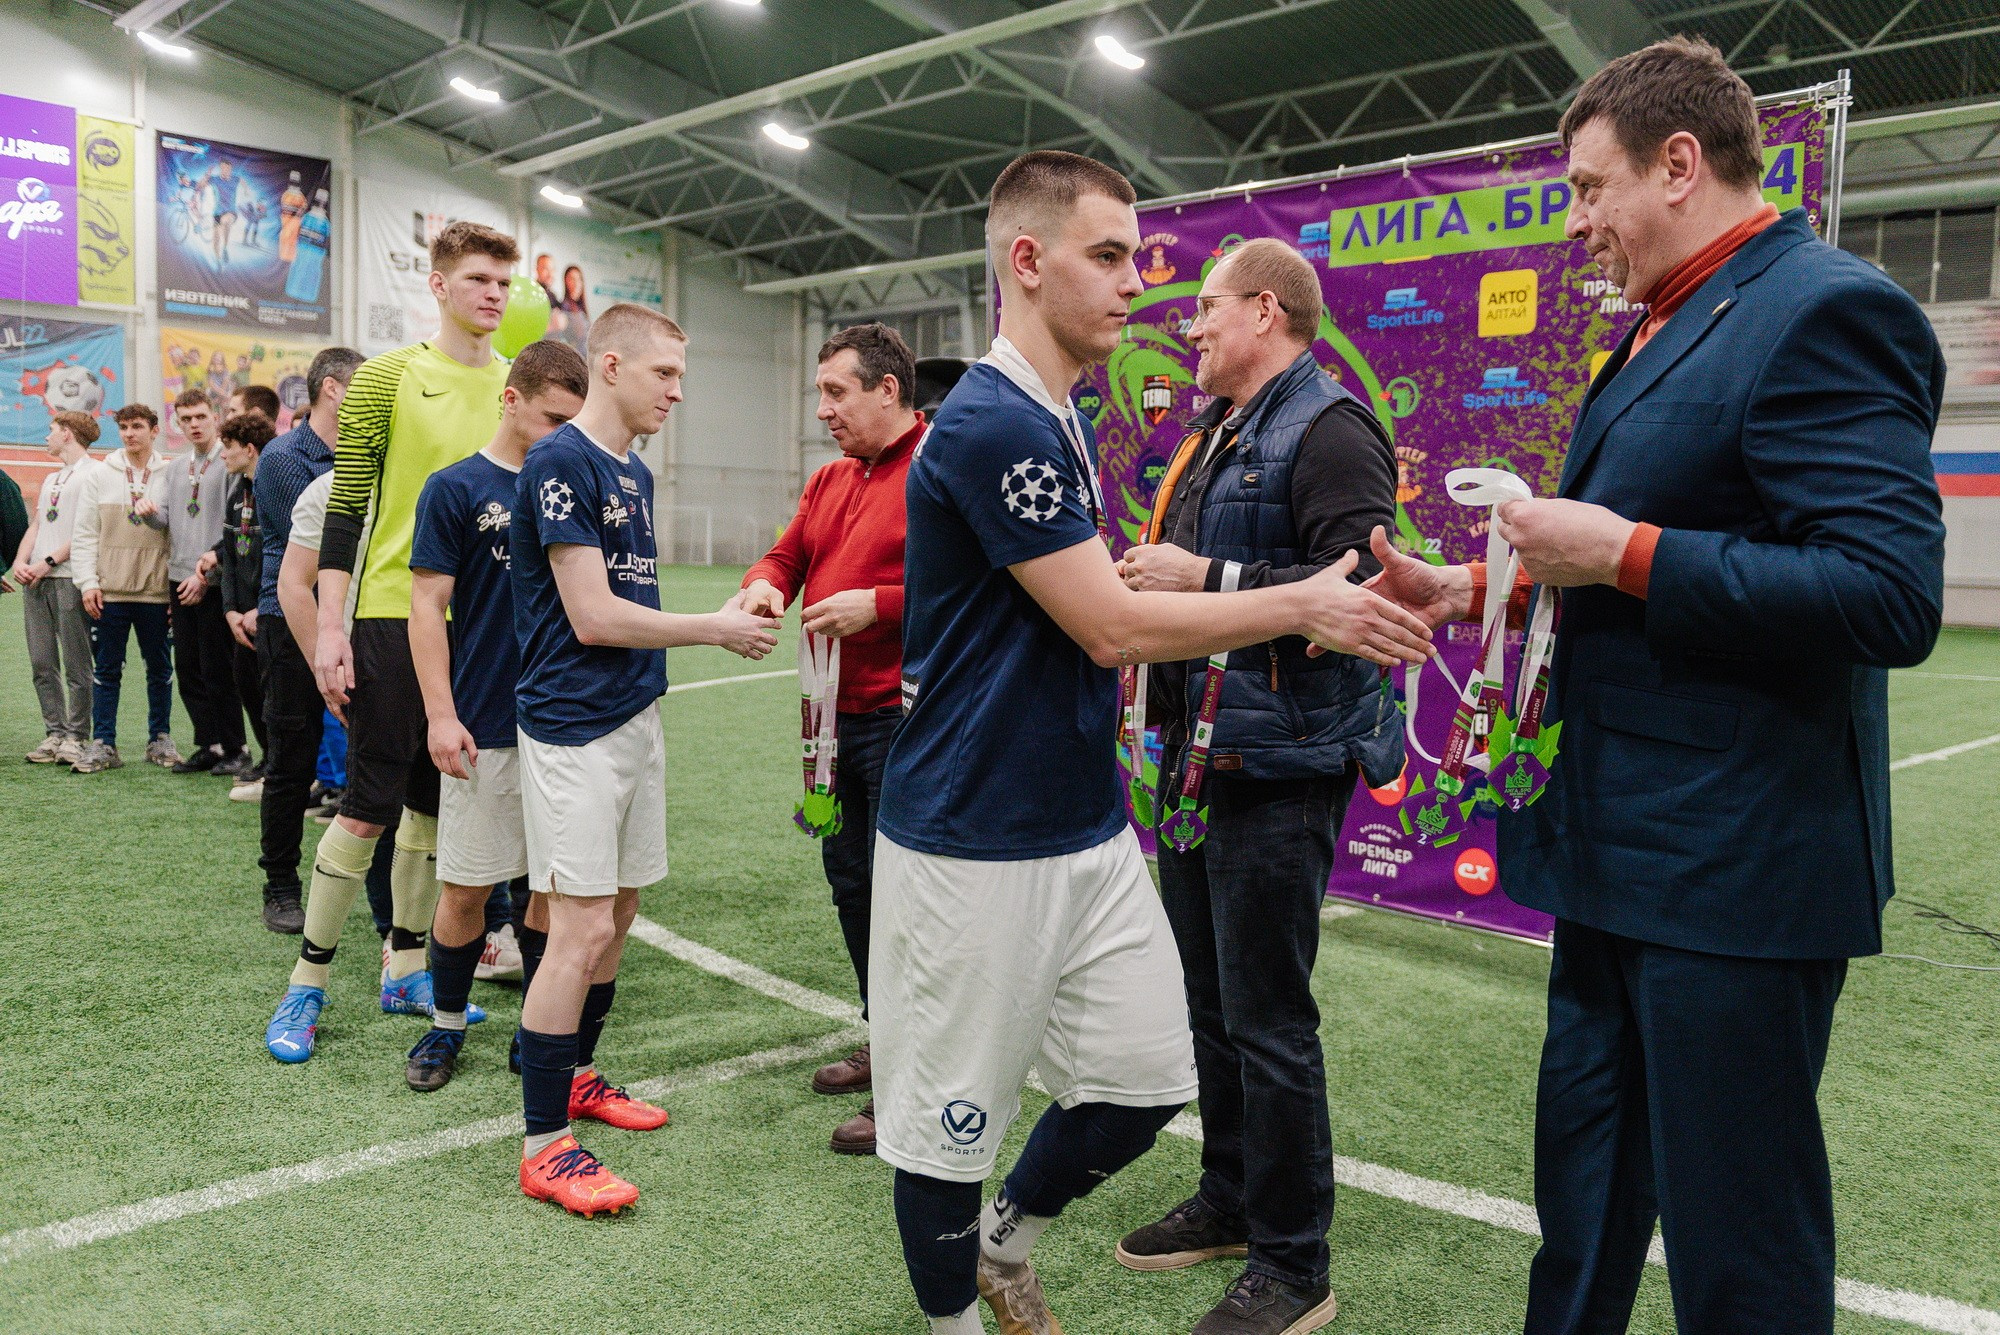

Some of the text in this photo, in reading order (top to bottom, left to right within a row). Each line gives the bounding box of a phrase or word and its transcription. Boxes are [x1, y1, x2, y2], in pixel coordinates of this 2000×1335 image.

[1341, 197, 1470, 251] ЛИГА
[1487, 289, 1527, 306] АКТО
[1366, 308, 1445, 330] SportLife
[1485, 305, 1528, 320] АЛТАЙ
[1461, 389, 1548, 411] SportLife
[1512, 798, 1521, 810] 2
[1417, 832, 1428, 845] 2
[1179, 843, 1186, 852] 2
[1348, 840, 1414, 865] ПРЕМЬЕР
[1361, 858, 1398, 879] ЛИГА
[940, 1143, 985, 1156] SPORTS
